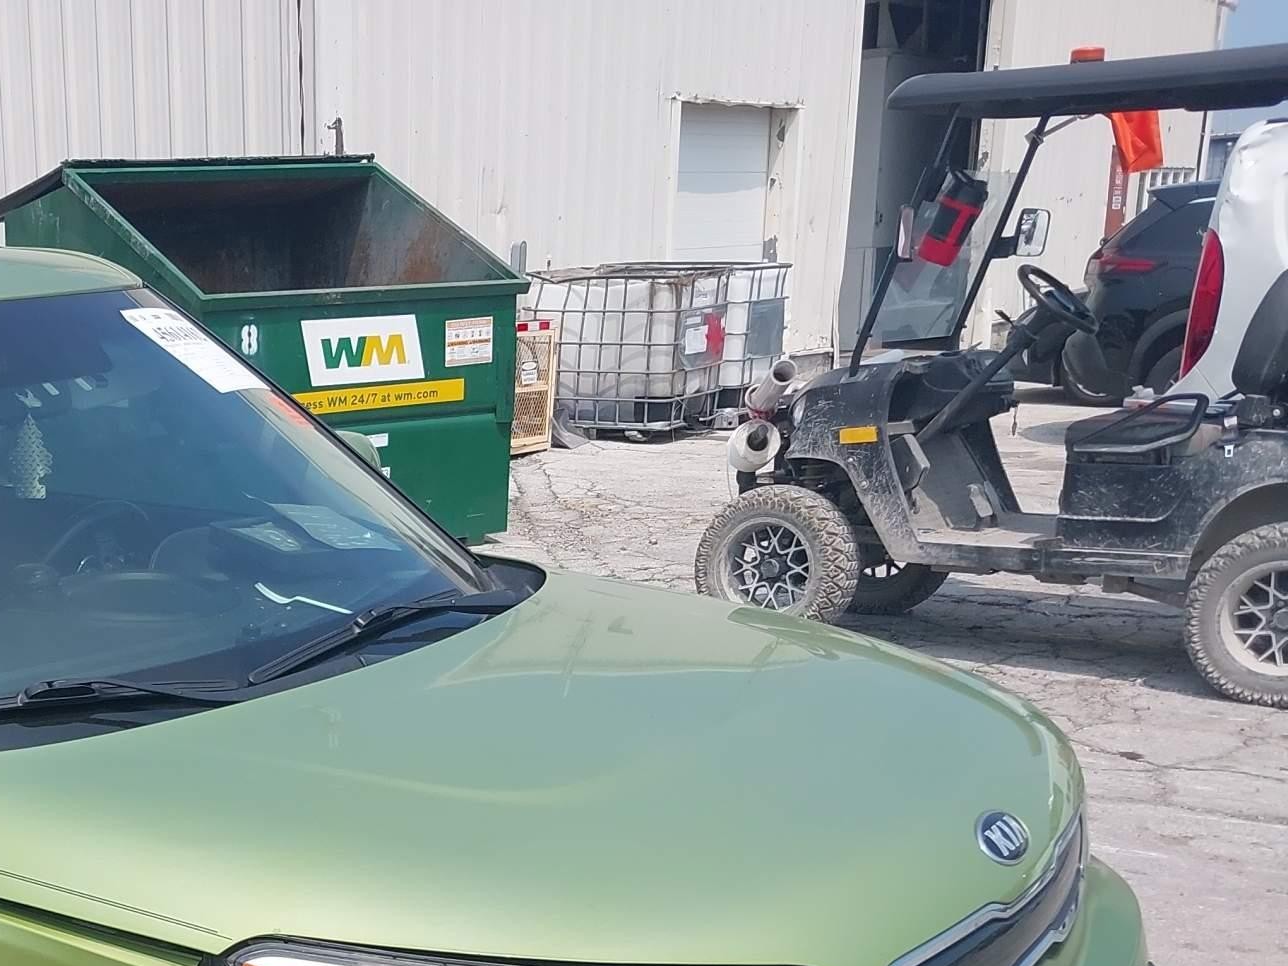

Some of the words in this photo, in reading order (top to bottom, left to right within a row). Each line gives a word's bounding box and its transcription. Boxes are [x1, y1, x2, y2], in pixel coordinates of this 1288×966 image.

[321, 334, 406, 369] WM
[327, 395, 348, 408] WM
[350, 392, 378, 406] 24/7
[380, 392, 391, 403] at
[394, 390, 439, 401] wm.com
[984, 815, 1027, 857] KIA
